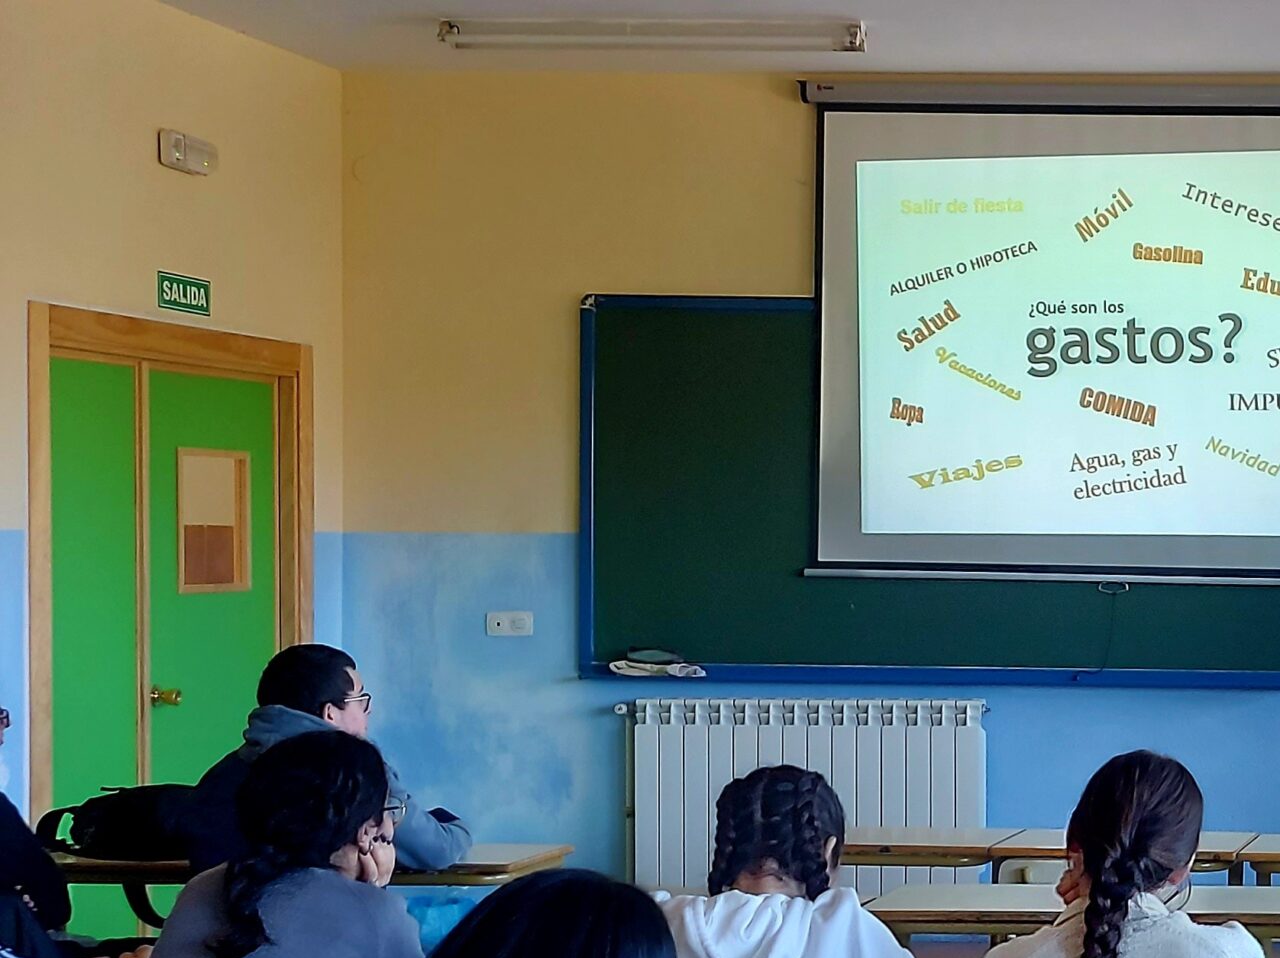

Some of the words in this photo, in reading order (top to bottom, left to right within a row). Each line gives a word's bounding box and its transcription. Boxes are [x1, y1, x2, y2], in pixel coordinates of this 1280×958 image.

[900, 198, 942, 214] Salir
[947, 198, 967, 214] de
[974, 198, 1024, 213] fiesta
[1074, 188, 1134, 243] Móvil
[890, 266, 954, 296] ALQUILER
[956, 262, 968, 274] O
[969, 241, 1037, 271] HIPOTECA
[1133, 242, 1203, 264] Gasolina
[163, 280, 206, 307] SALIDA
[1029, 300, 1066, 317] ¿Qué
[1071, 304, 1097, 314] son
[1103, 300, 1124, 314] los
[897, 299, 961, 352] Salud
[1026, 313, 1242, 377] gastos?
[935, 346, 1022, 400] Vacaciones
[890, 397, 924, 426] Ropa
[1079, 387, 1157, 427] COMIDA
[908, 454, 1024, 489] Viajes
[1069, 453, 1125, 473] Agua,
[1132, 446, 1161, 466] gas
[1166, 444, 1177, 461] y
[1074, 466, 1187, 499] electricidad
